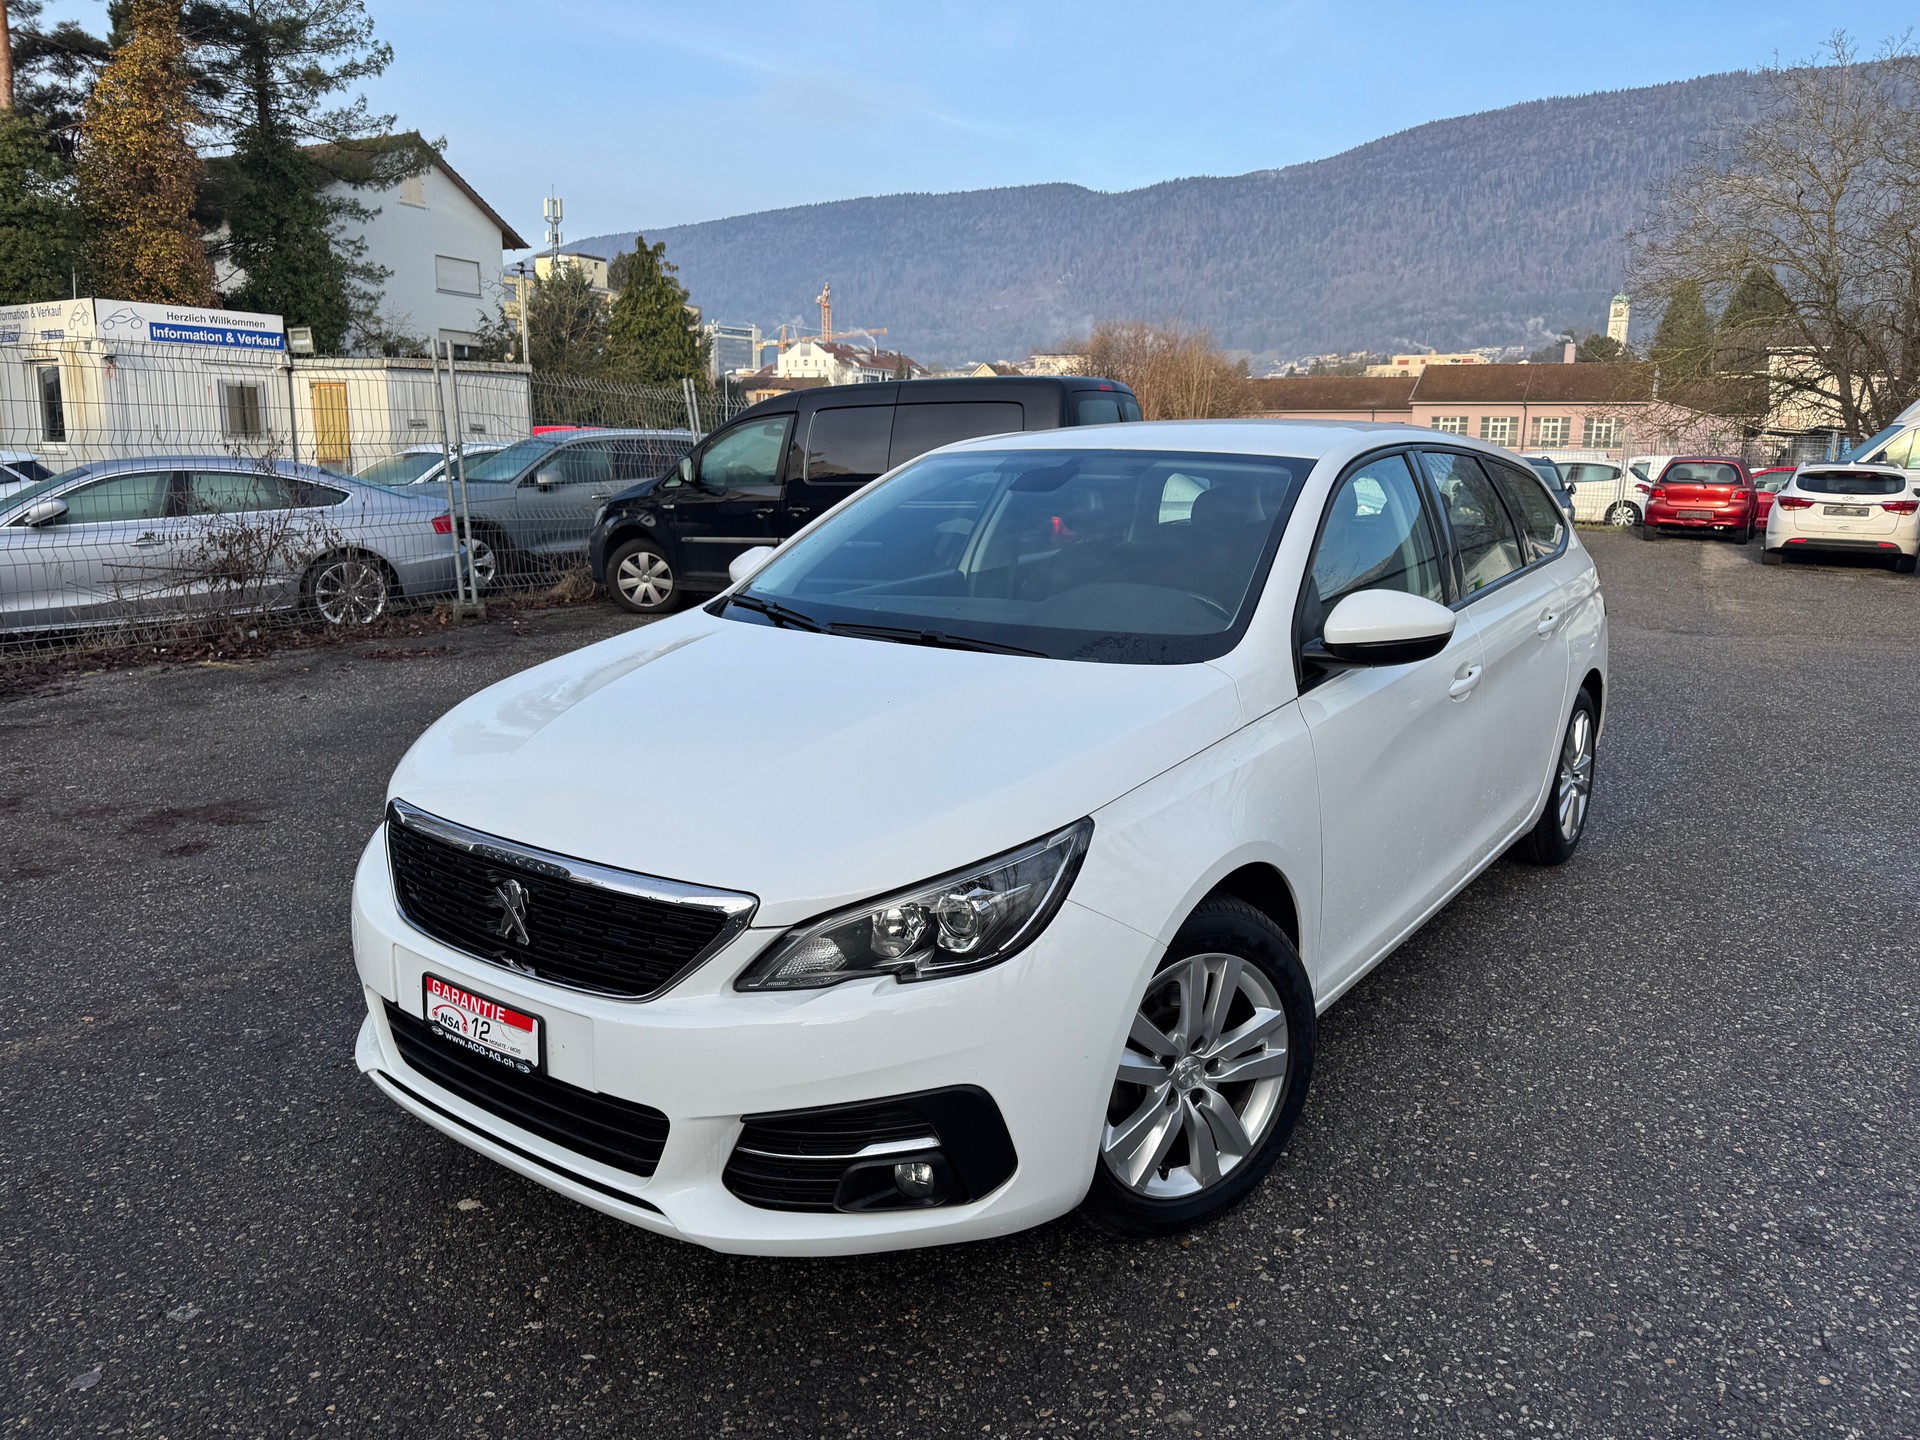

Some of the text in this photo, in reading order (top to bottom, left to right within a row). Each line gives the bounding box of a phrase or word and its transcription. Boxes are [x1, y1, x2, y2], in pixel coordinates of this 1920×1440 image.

[30, 306, 36, 319] &
[36, 304, 62, 318] Verkauf
[166, 312, 266, 328] Herzlich Willkommen
[152, 326, 281, 346] Information & Verkauf
[432, 979, 506, 1022] GARANTIE
[440, 1012, 460, 1031] NSA
[471, 1017, 491, 1042] 12
[444, 1031, 515, 1068] www.ACG-AG.ch
